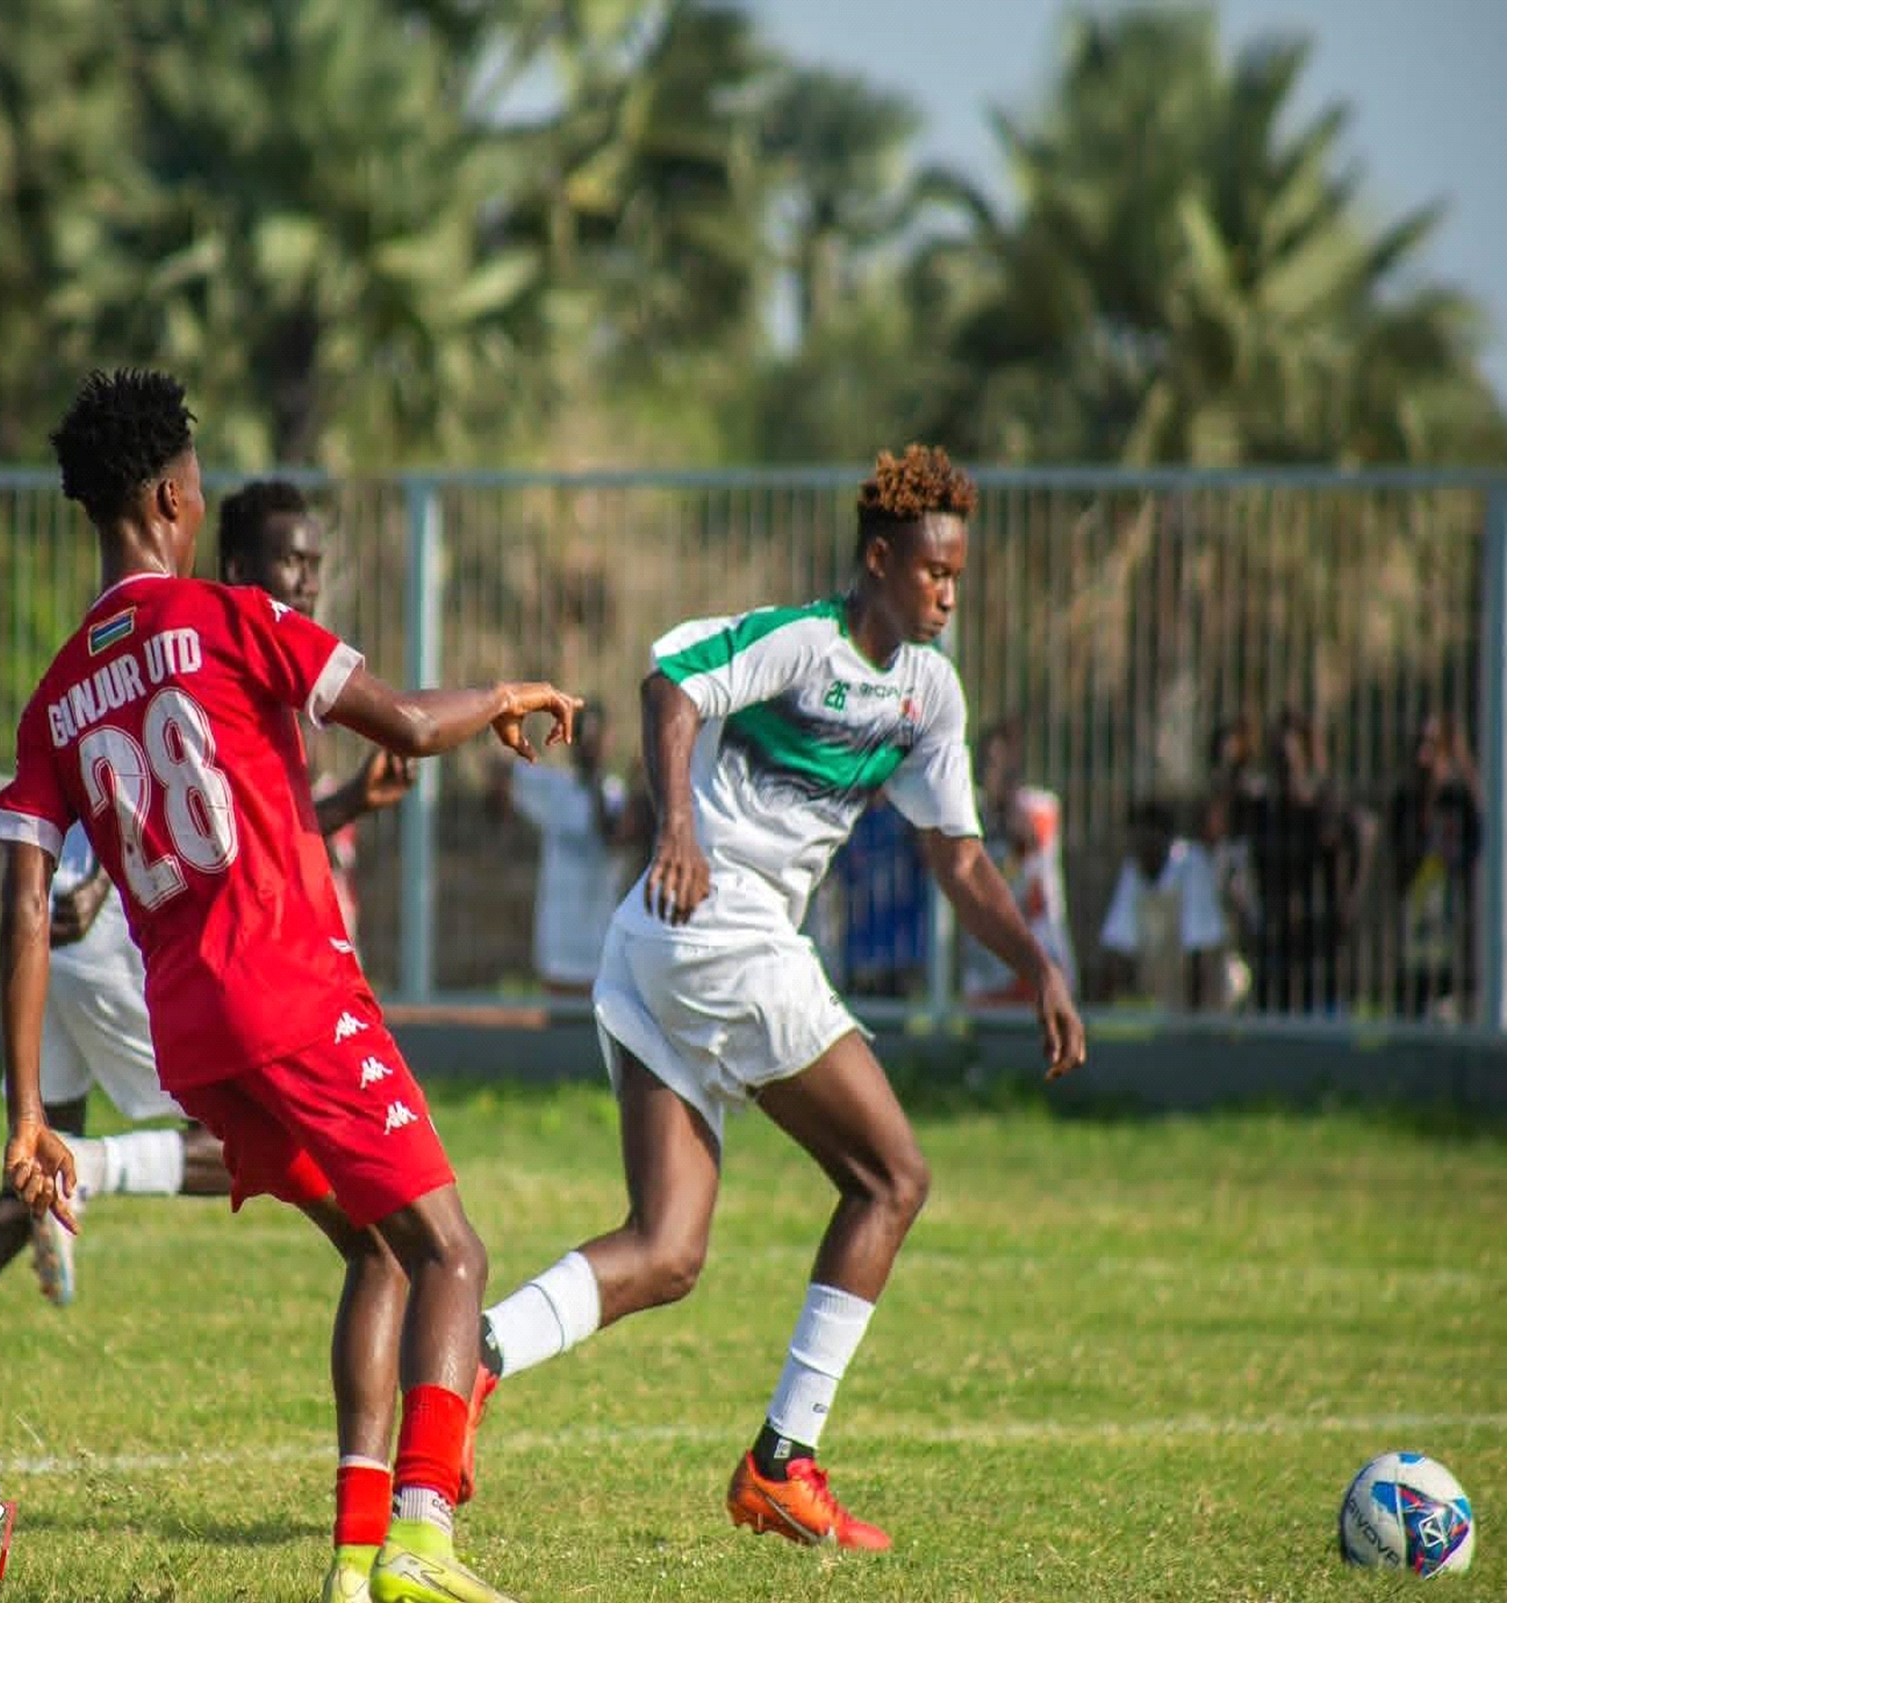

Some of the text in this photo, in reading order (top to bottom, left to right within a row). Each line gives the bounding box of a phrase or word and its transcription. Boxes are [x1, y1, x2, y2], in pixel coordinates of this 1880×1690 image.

[48, 628, 202, 748] GUNJUR UTD
[823, 679, 851, 712] 26
[79, 687, 239, 912] 28
